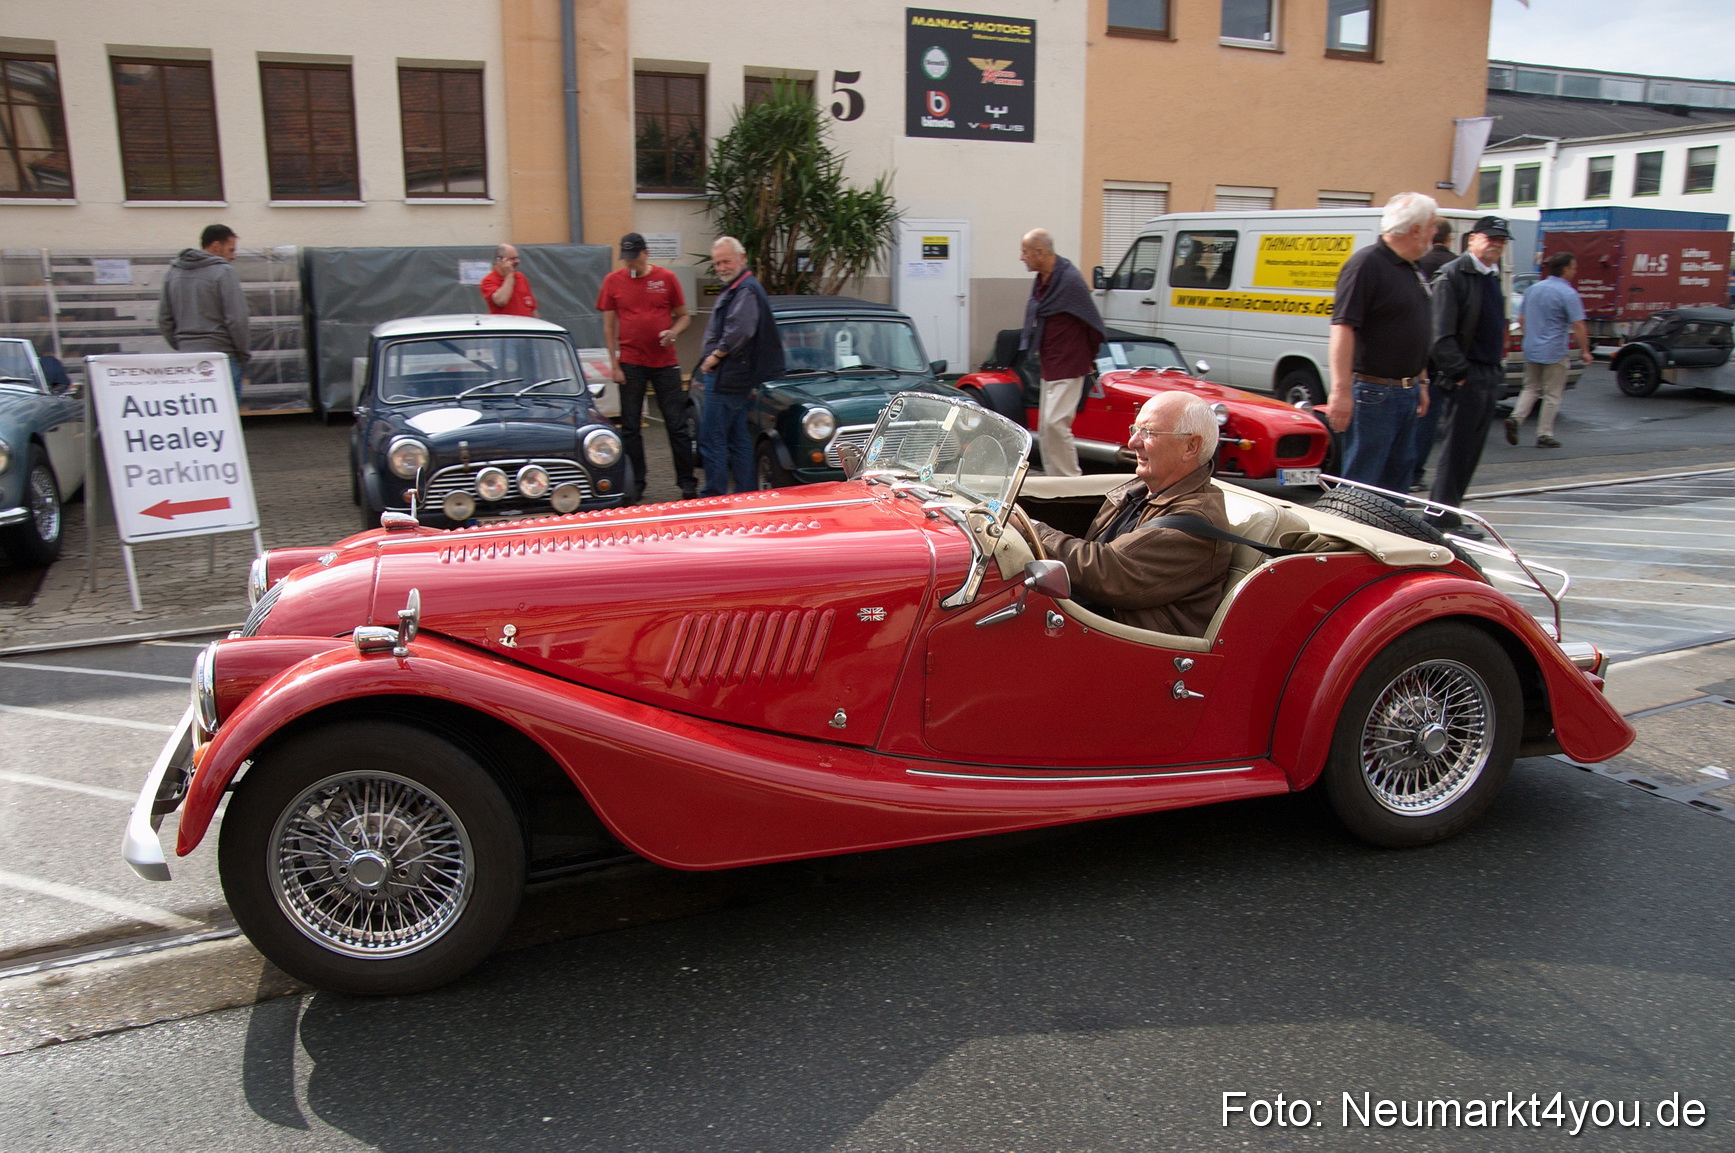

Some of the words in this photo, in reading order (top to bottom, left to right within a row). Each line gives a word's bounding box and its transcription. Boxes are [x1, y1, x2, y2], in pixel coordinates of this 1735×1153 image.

[911, 15, 1032, 36] MANIAC-MOTORS
[831, 70, 865, 122] 5
[1260, 236, 1353, 252] MANIAC-MOTORS
[1632, 253, 1669, 272] M+S
[1177, 294, 1334, 315] www.maniacmotors.de
[107, 366, 196, 378] OFENWERK
[121, 393, 218, 418] Austin
[124, 426, 225, 453] Healey
[123, 459, 239, 488] Parking
